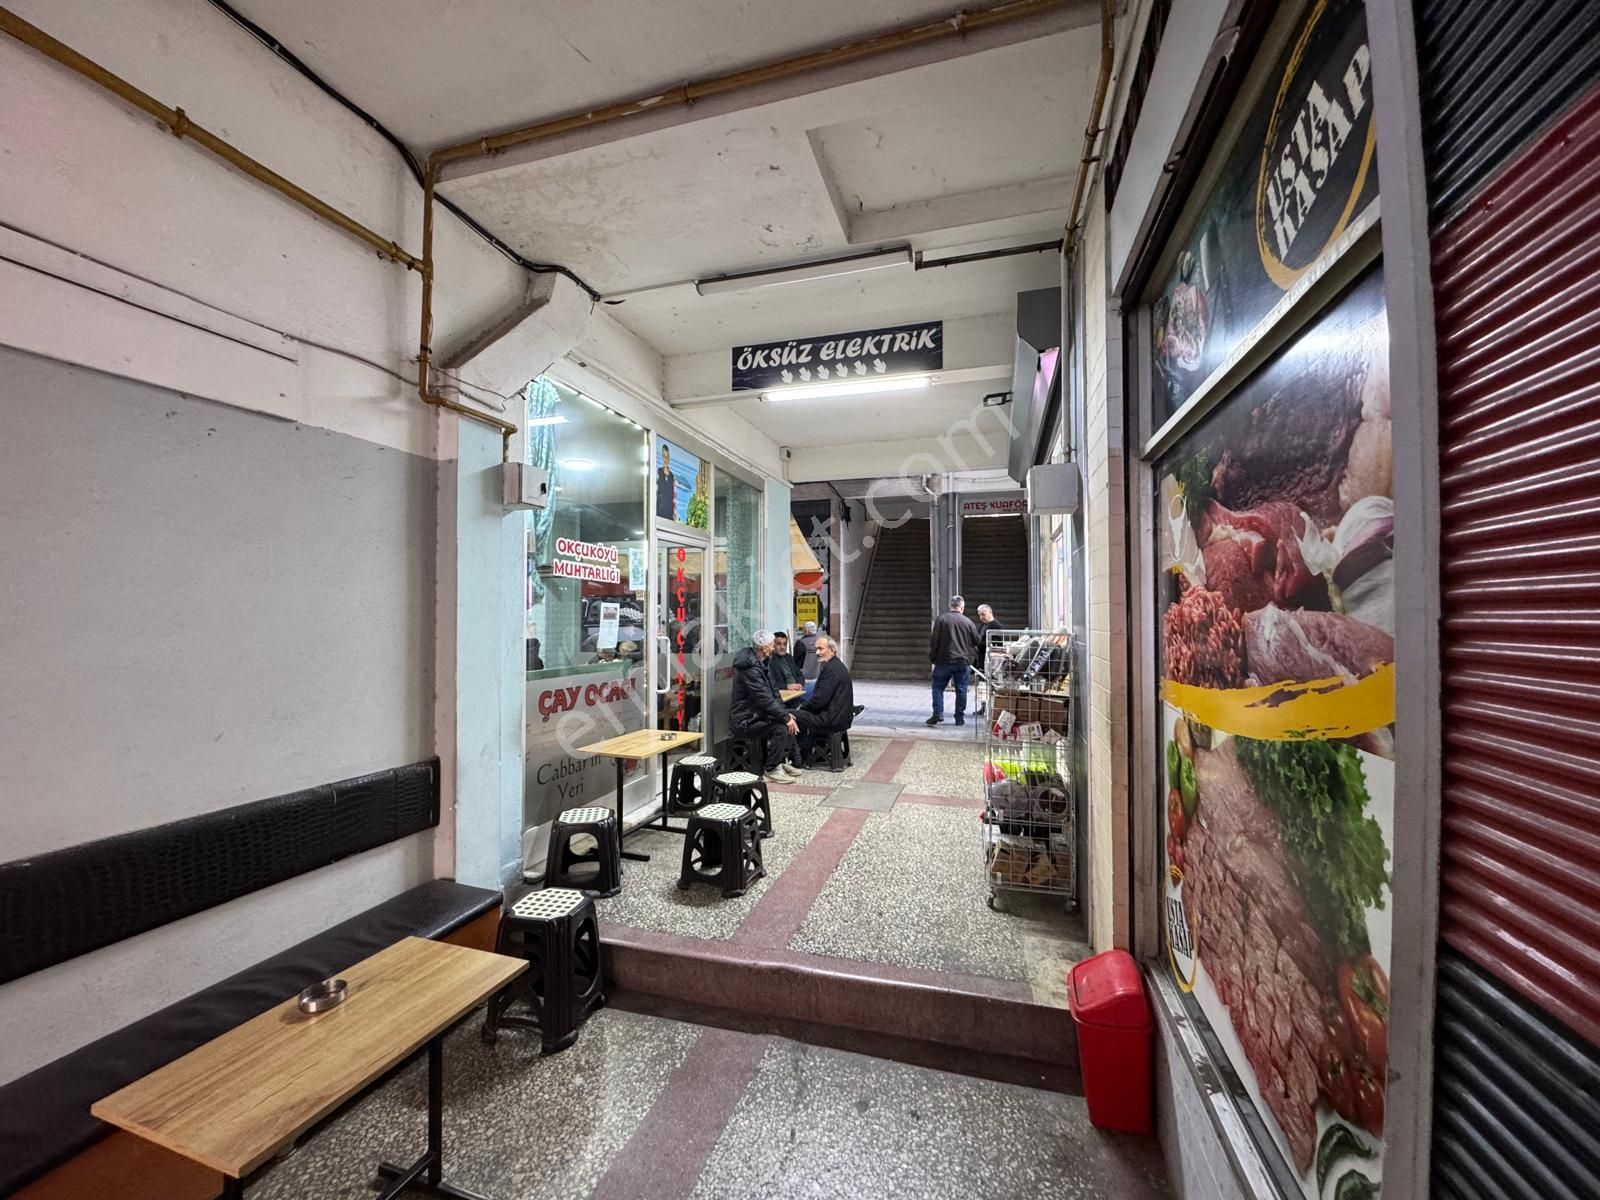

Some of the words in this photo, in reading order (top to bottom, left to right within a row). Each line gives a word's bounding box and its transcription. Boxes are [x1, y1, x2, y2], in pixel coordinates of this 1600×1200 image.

[1267, 79, 1332, 223] USTA
[1273, 44, 1370, 263] KASAP
[737, 341, 813, 371] ÖKSÜZ
[963, 502, 987, 511] ATEŞ
[557, 538, 617, 562] OKÇUKÖYÜ
[554, 561, 619, 582] MUHTARLIĞI
[538, 686, 582, 722] ÇAY
[558, 777, 584, 806] Yeri
